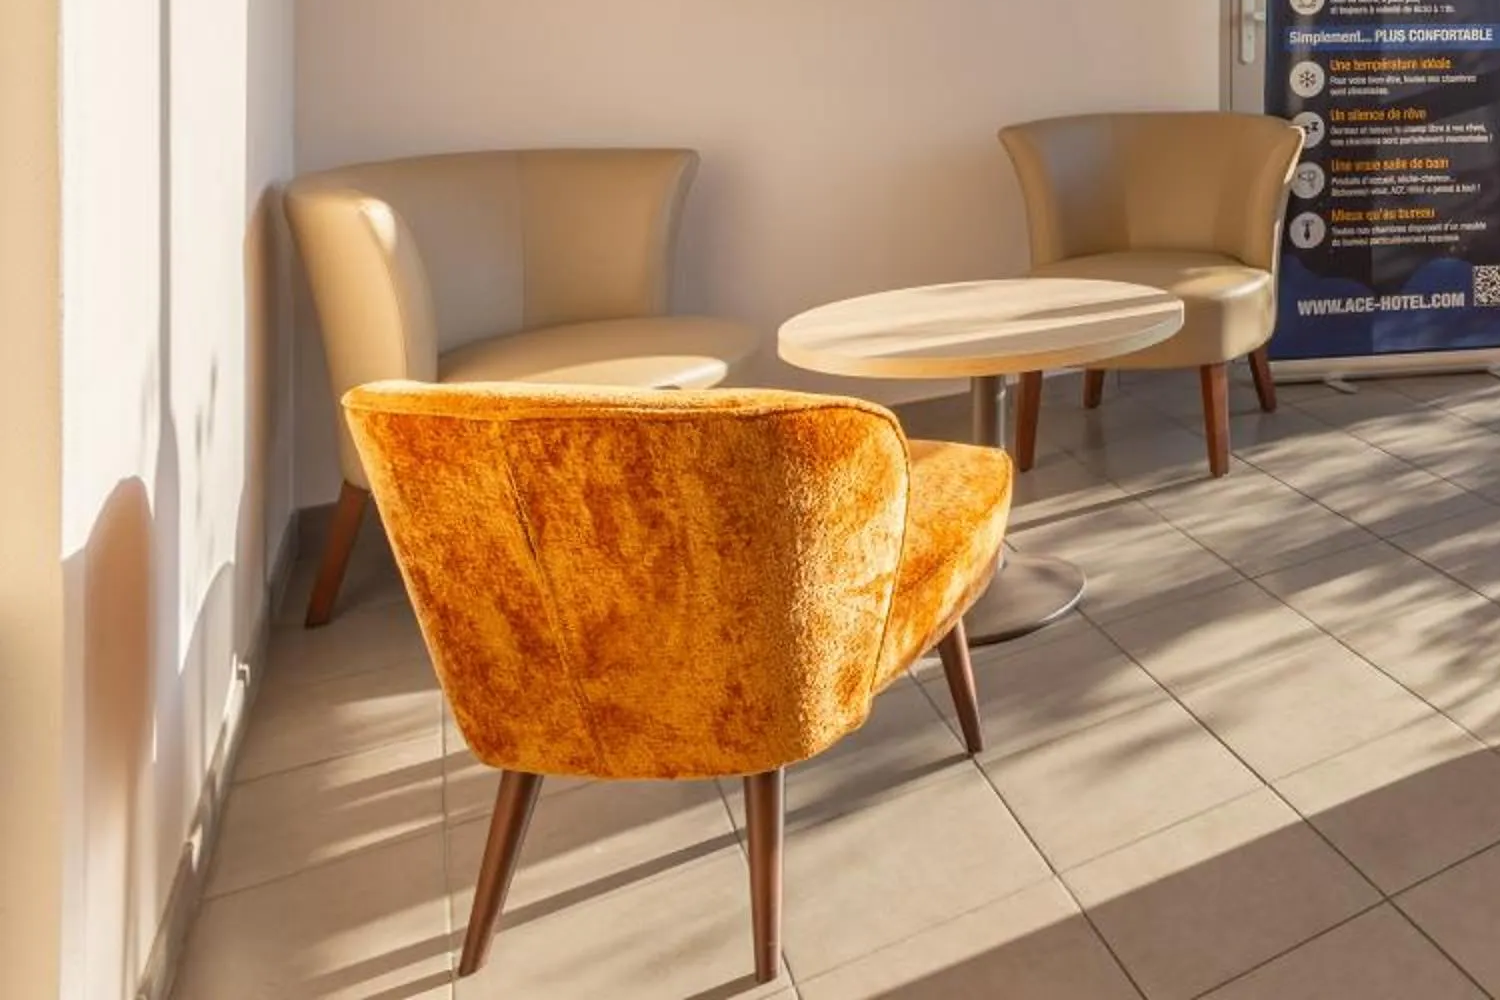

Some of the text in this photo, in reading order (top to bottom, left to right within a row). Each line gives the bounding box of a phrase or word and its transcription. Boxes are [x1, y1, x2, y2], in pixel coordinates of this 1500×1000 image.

[1289, 29, 1493, 45] Simplement... PLUS CONFORTABLE
[1330, 59, 1351, 71] Une
[1354, 58, 1418, 72] température
[1331, 109, 1345, 121] Un
[1348, 108, 1384, 121] silence
[1387, 108, 1401, 121] de
[1331, 159, 1351, 172] Une
[1410, 158, 1423, 169] de
[1297, 292, 1465, 316] WWW.ACE-HOTEL.COM
